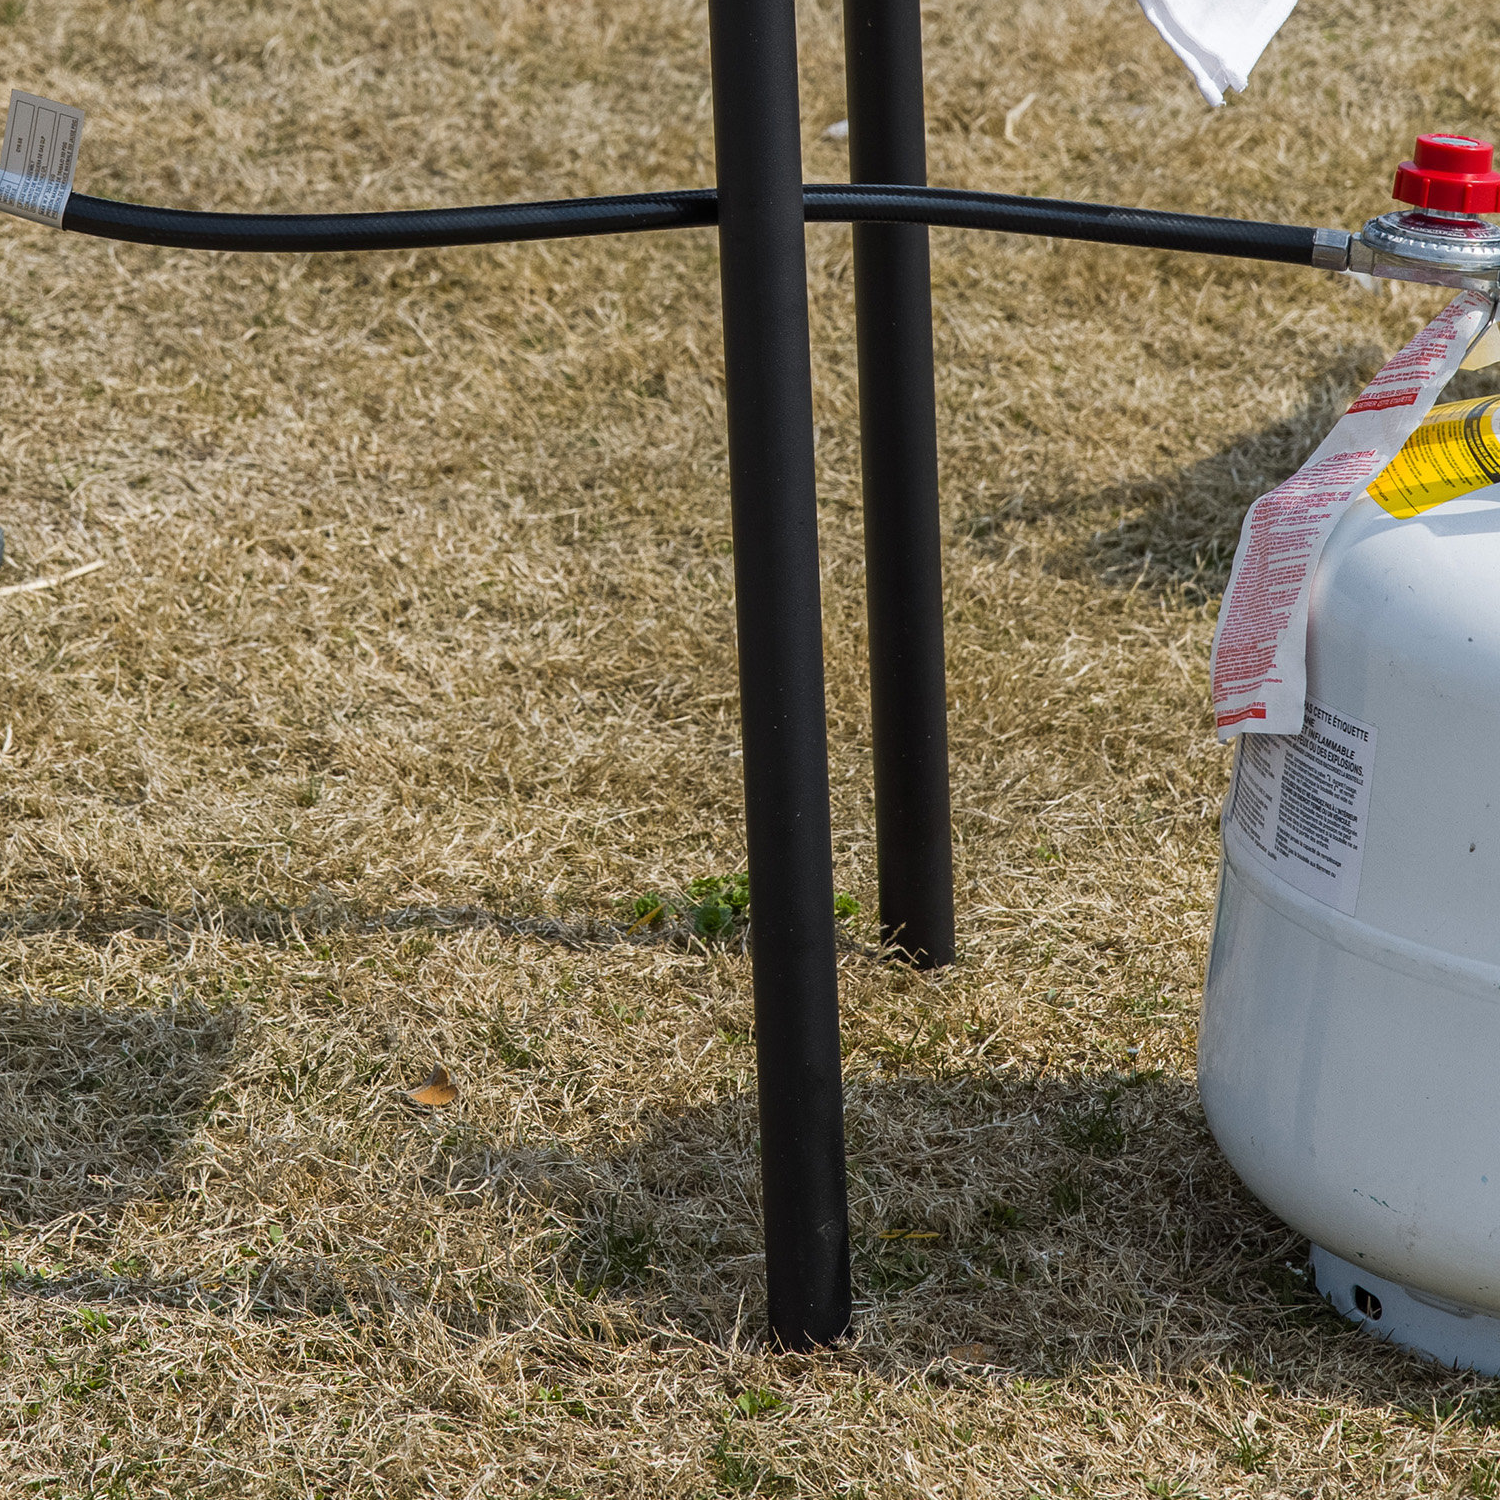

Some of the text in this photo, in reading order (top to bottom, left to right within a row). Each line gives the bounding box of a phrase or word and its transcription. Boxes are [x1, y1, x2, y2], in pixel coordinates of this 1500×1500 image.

[1314, 707, 1332, 724] CETTE
[1332, 714, 1369, 742] ÉTIQUETTE
[1309, 729, 1355, 760] INFLAMMABLE
[1328, 751, 1364, 777] EXPLOSIONS.
